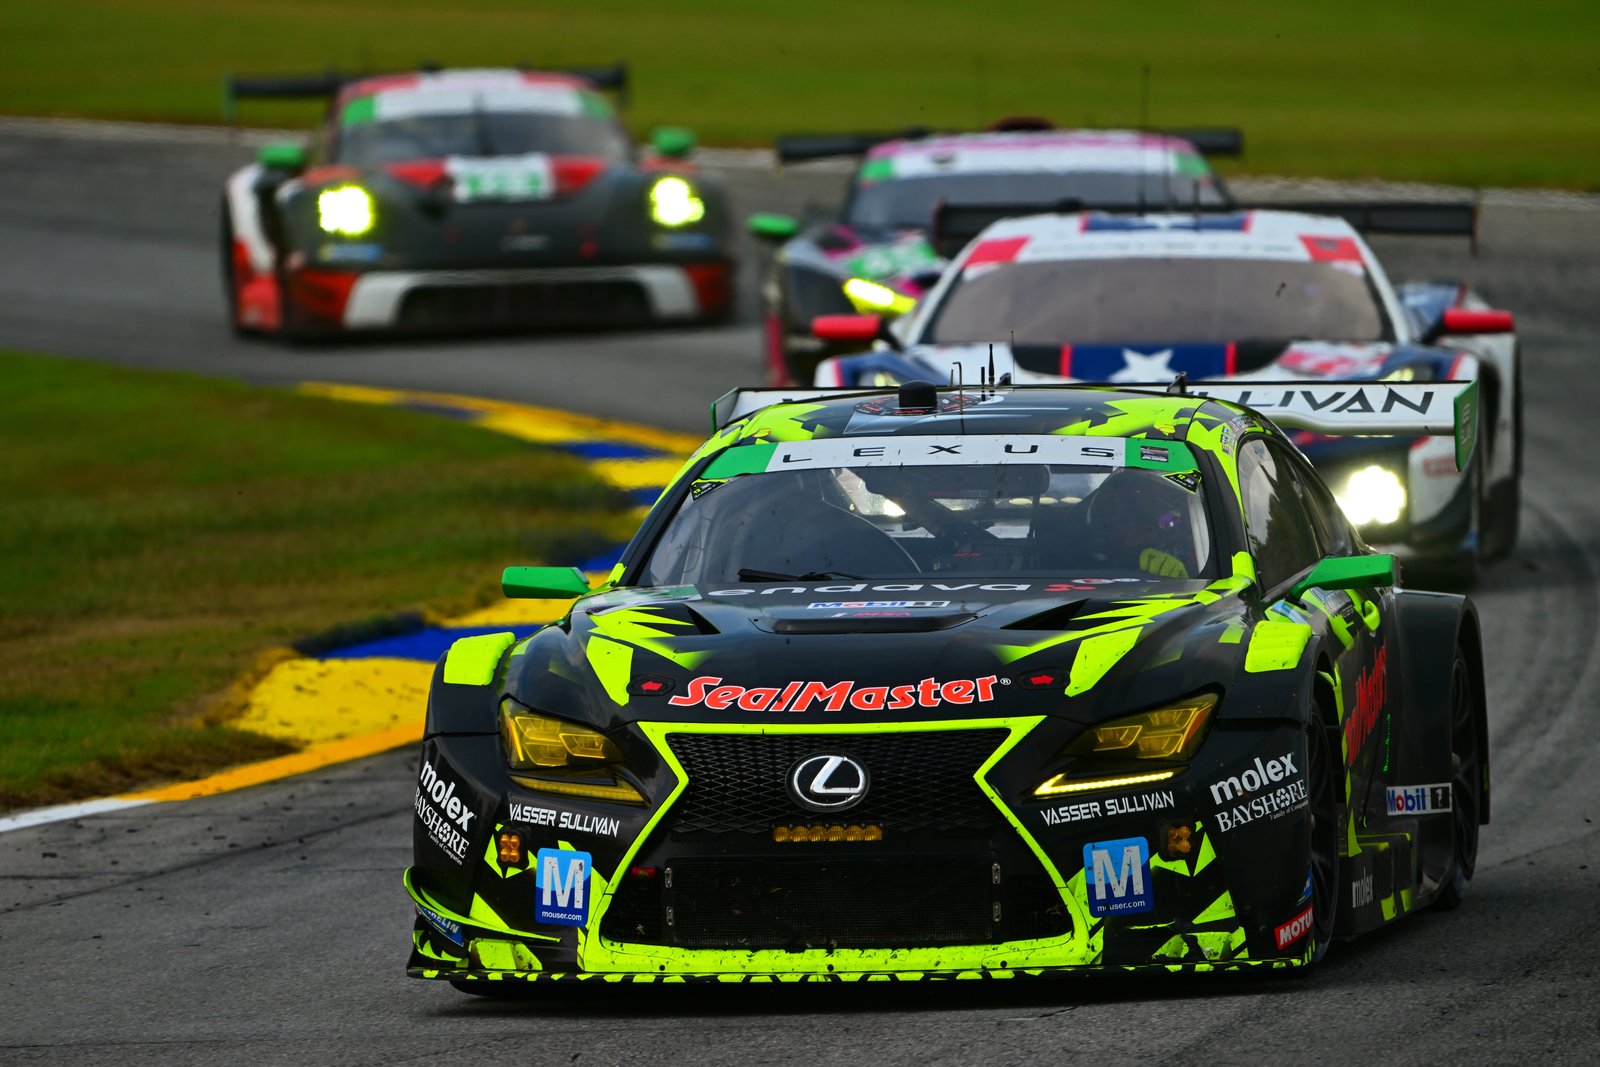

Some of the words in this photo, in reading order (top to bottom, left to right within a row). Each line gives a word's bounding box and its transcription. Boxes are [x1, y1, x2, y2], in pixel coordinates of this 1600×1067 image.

[782, 444, 1115, 464] LEXUS
[708, 583, 1032, 597] endava
[420, 760, 475, 833] molex
[1210, 753, 1299, 806] molex
[1040, 801, 1102, 827] VASSER
[1105, 790, 1175, 816] SULLIVAN
[1215, 779, 1308, 833] BAYSHORE
[1387, 788, 1427, 812] Mobil
[509, 803, 557, 828] VASSER
[558, 812, 620, 838] SULLIVAN
[542, 856, 585, 909] M
[1092, 845, 1145, 900] M
[1351, 866, 1374, 909] molex
[541, 910, 583, 922] mouser.com
[1097, 900, 1146, 912] muser.com
